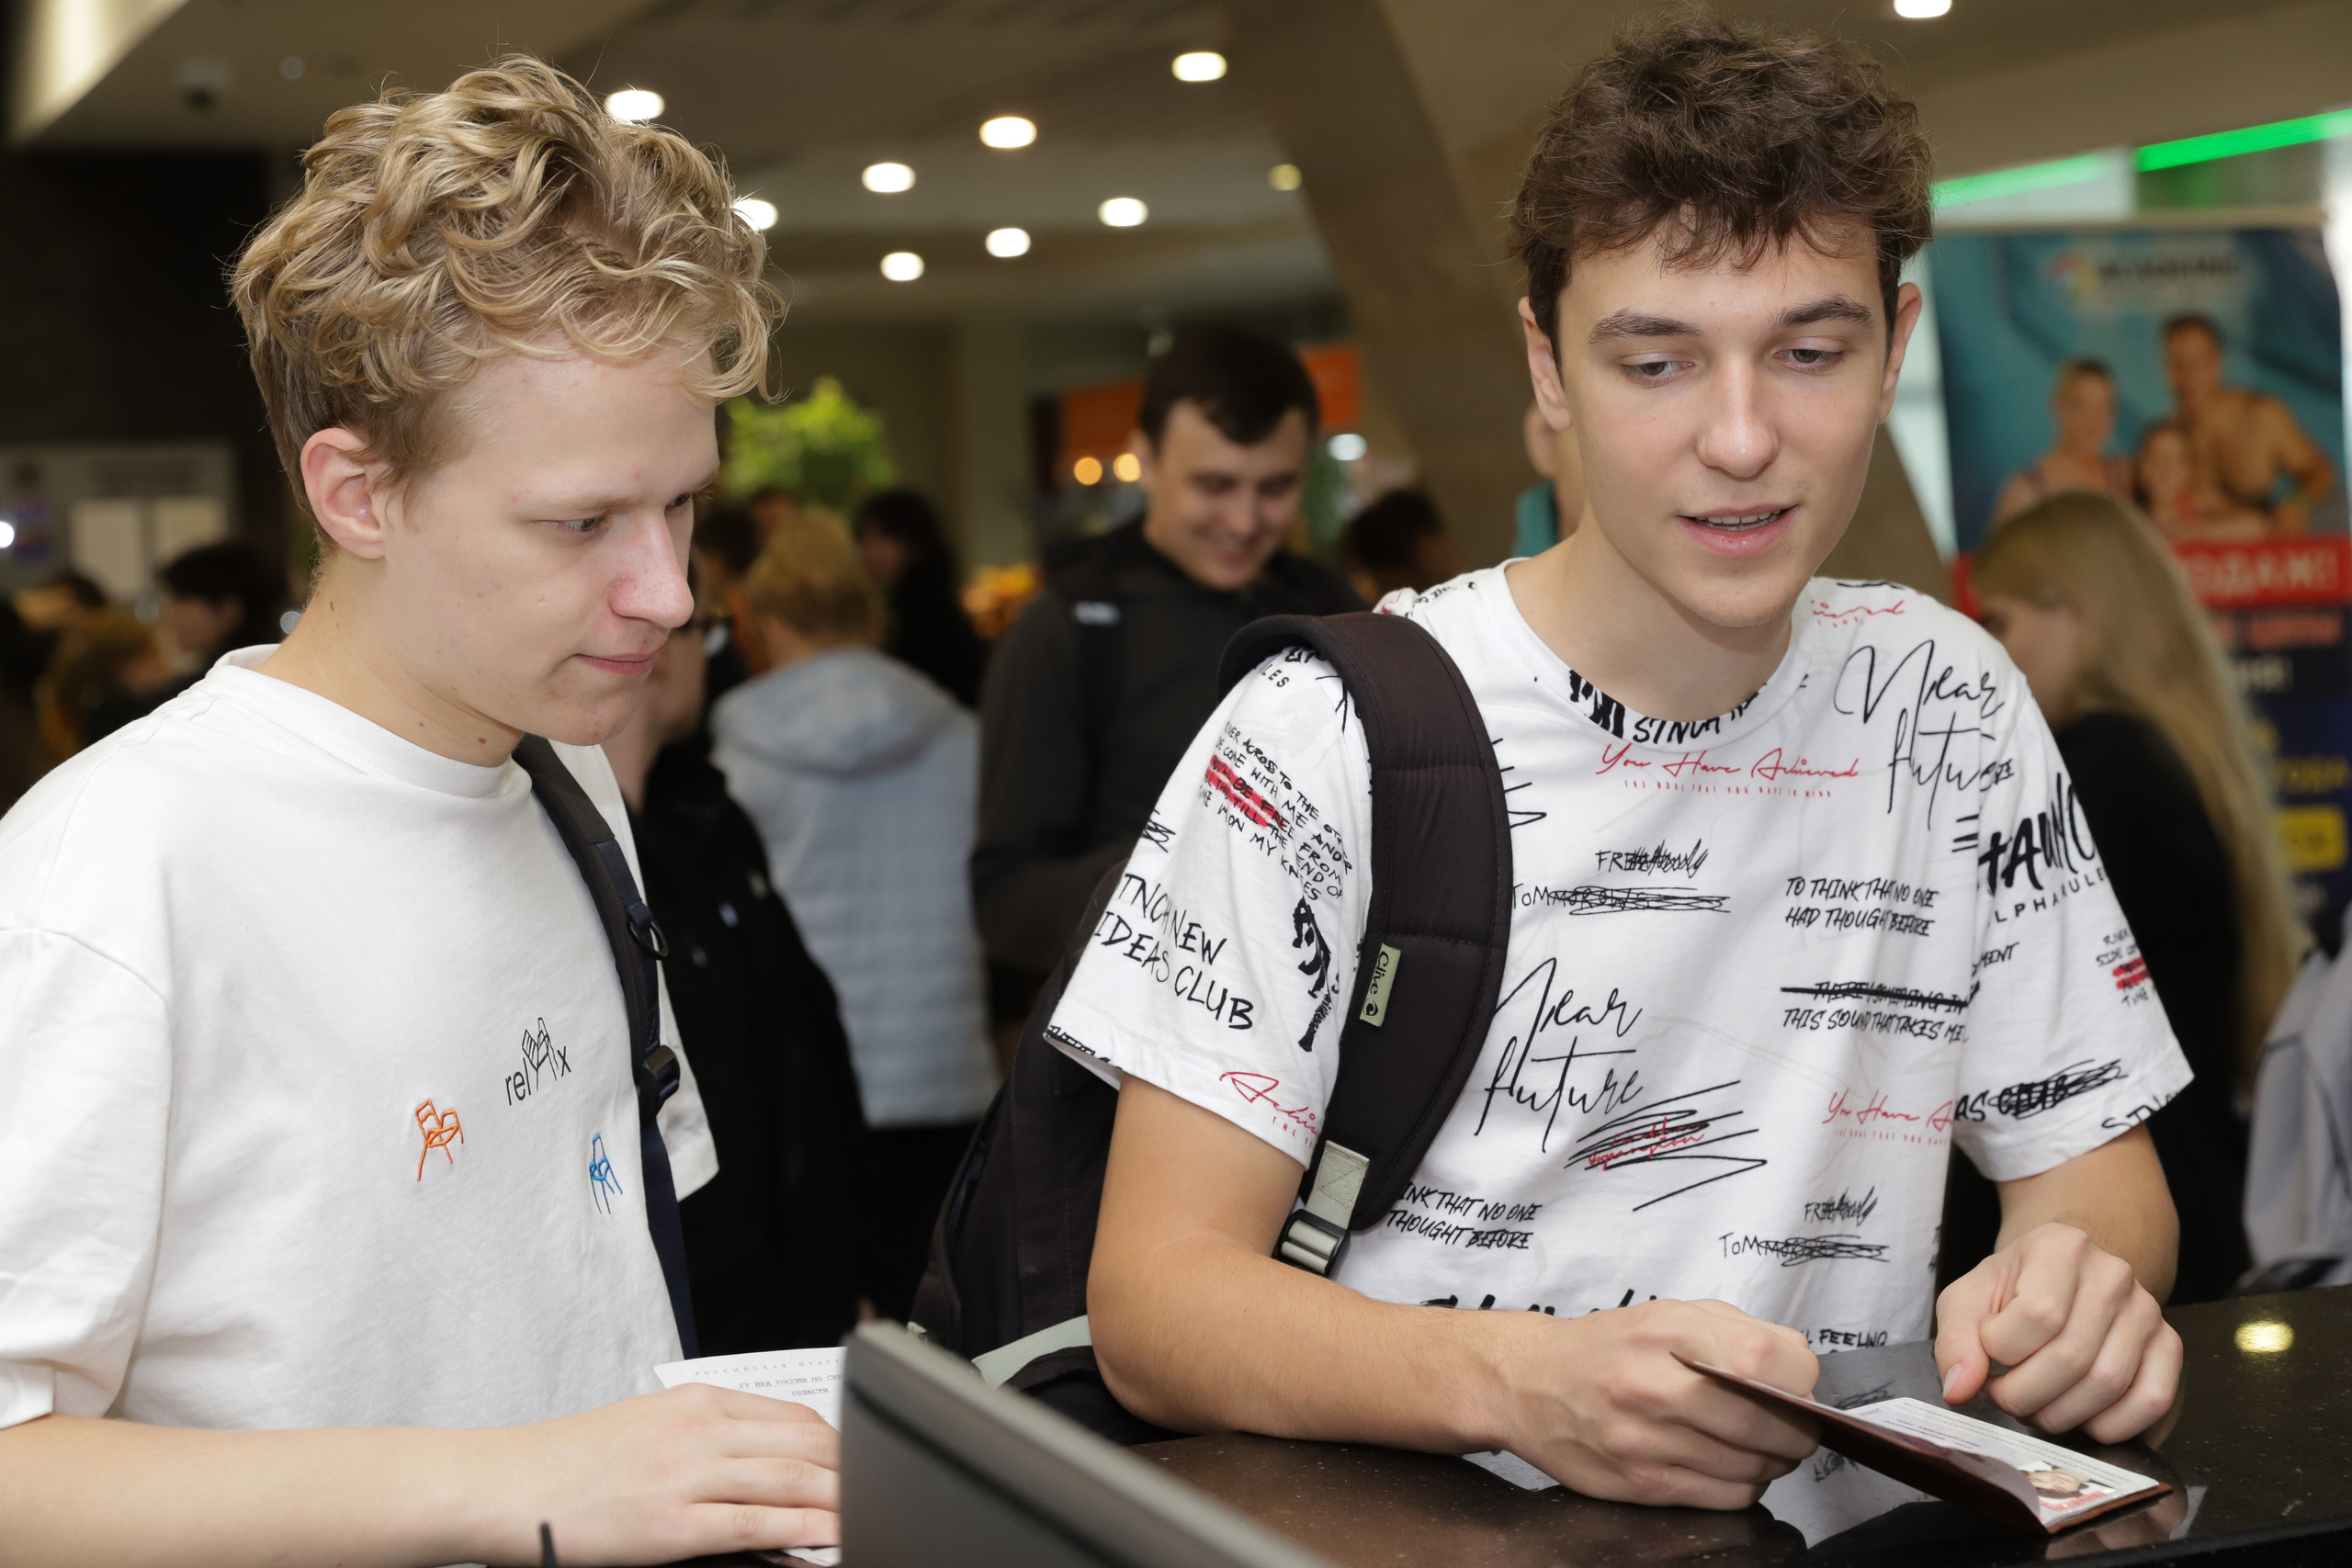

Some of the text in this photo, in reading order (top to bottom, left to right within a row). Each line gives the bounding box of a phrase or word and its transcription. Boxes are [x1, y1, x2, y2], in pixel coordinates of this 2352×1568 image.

[1242, 738, 1278, 774] ACROSS
[1279, 771, 1293, 791] TO
[1296, 791, 1319, 821] THE
[1662, 750, 1741, 778] Have
[1250, 767, 1279, 800] WITH
[1281, 799, 1308, 829] ME
[1310, 832, 1342, 862] AND
[1233, 777, 1254, 799] BE
[1299, 842, 1341, 886] FROM
[1250, 833, 1277, 858] MY
[1785, 875, 1806, 897] TO
[1810, 877, 1865, 902] THINK
[1785, 906, 1821, 929] HAD
[1093, 910, 1255, 1031] IDEAS CLUB
[1370, 950, 1390, 995] Clive
[1782, 1009, 1826, 1031] THIS
[1894, 1014, 1946, 1040] TAKES
[1436, 1191, 1485, 1217] THAT
[1477, 1201, 1507, 1222] NO
[1506, 1202, 1544, 1223] ONE
[1386, 1209, 1534, 1250] THOUGHT BEFORE
[775, 1378, 808, 1386] РОССИИ
